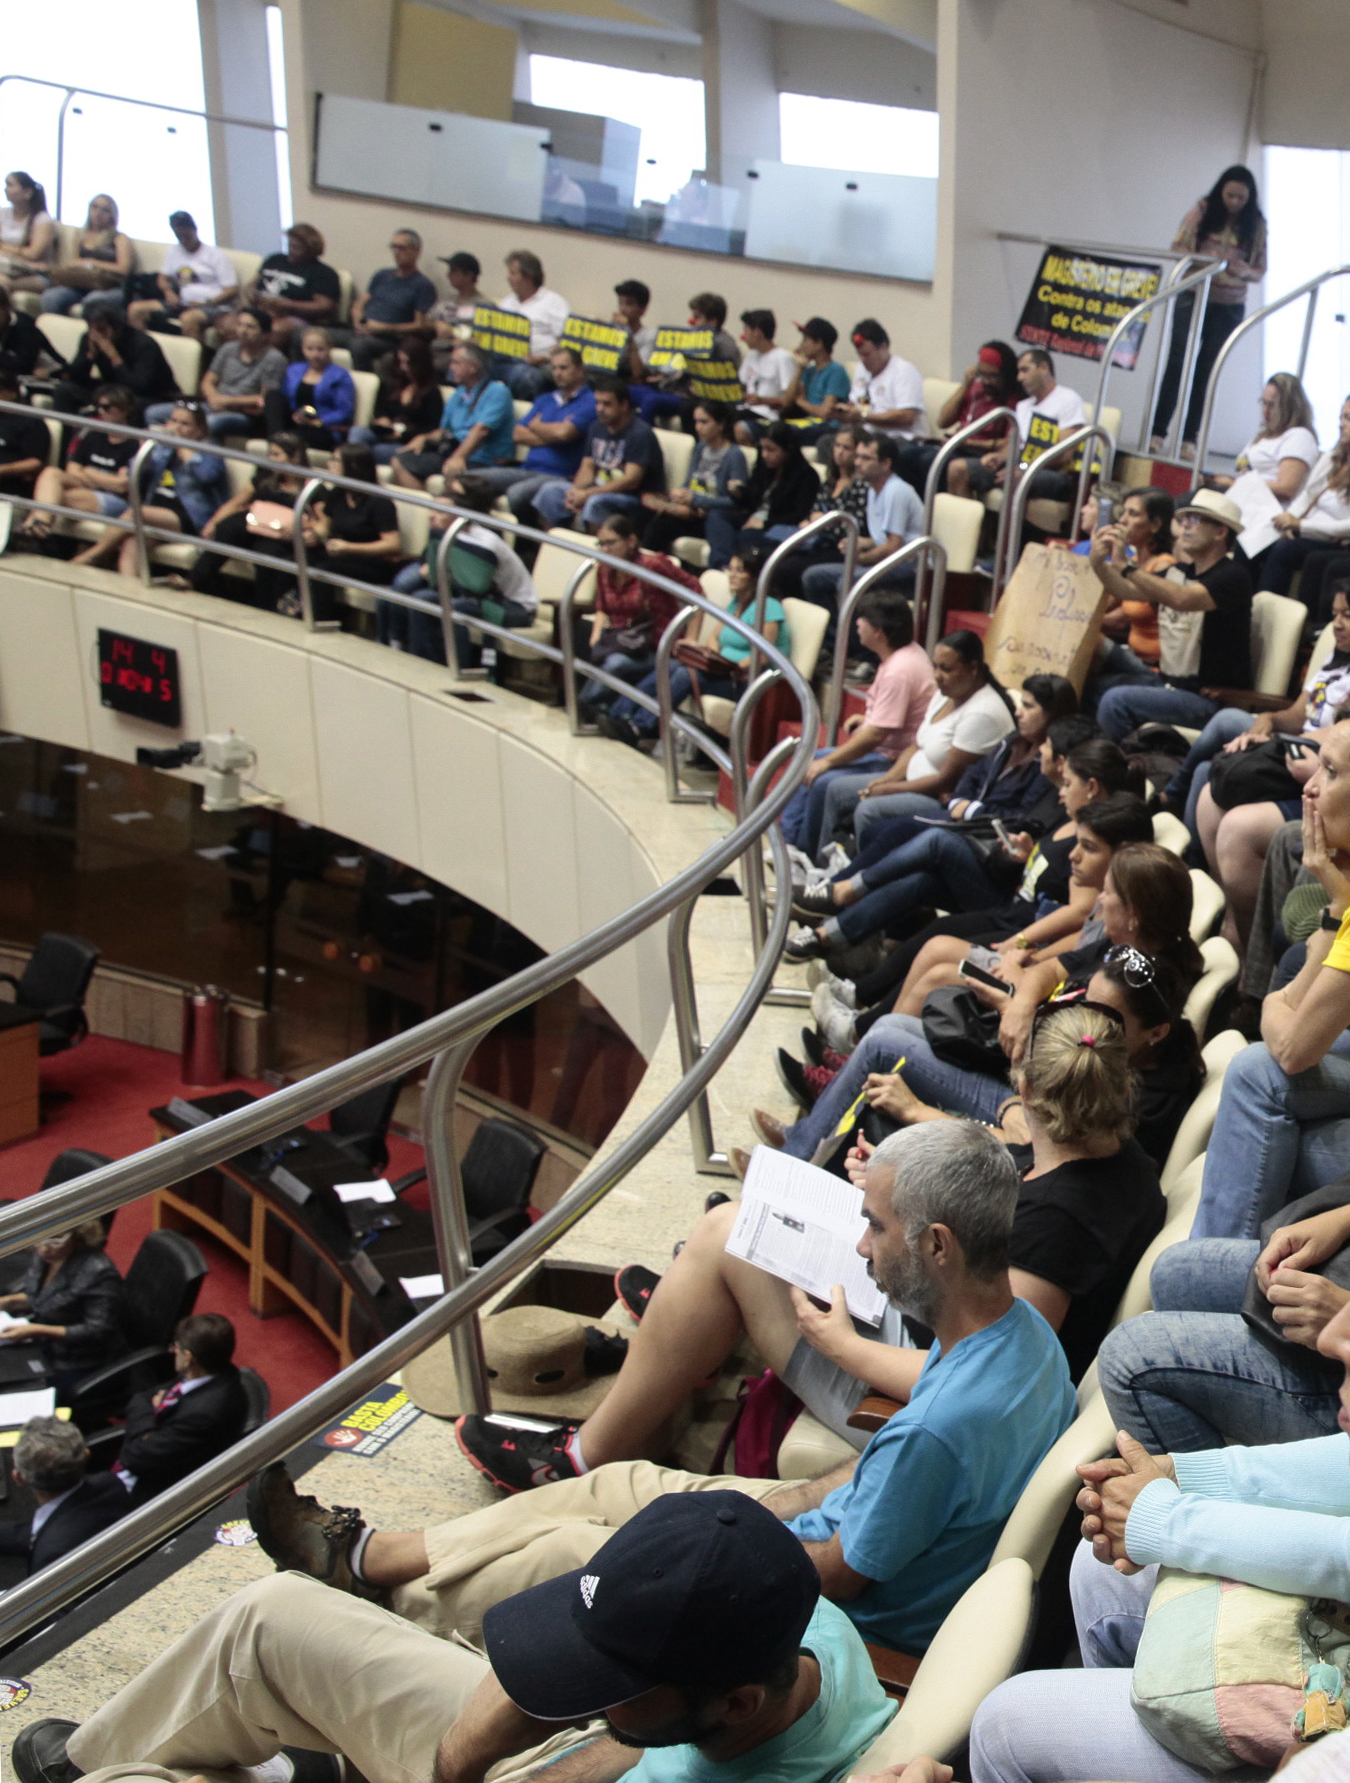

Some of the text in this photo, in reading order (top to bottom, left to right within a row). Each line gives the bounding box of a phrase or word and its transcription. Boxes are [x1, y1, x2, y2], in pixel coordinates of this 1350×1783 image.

[1037, 285, 1085, 311] Contra
[1085, 299, 1102, 315] os
[340, 1401, 385, 1429] BASTA
[580, 1575, 594, 1609] adidas
